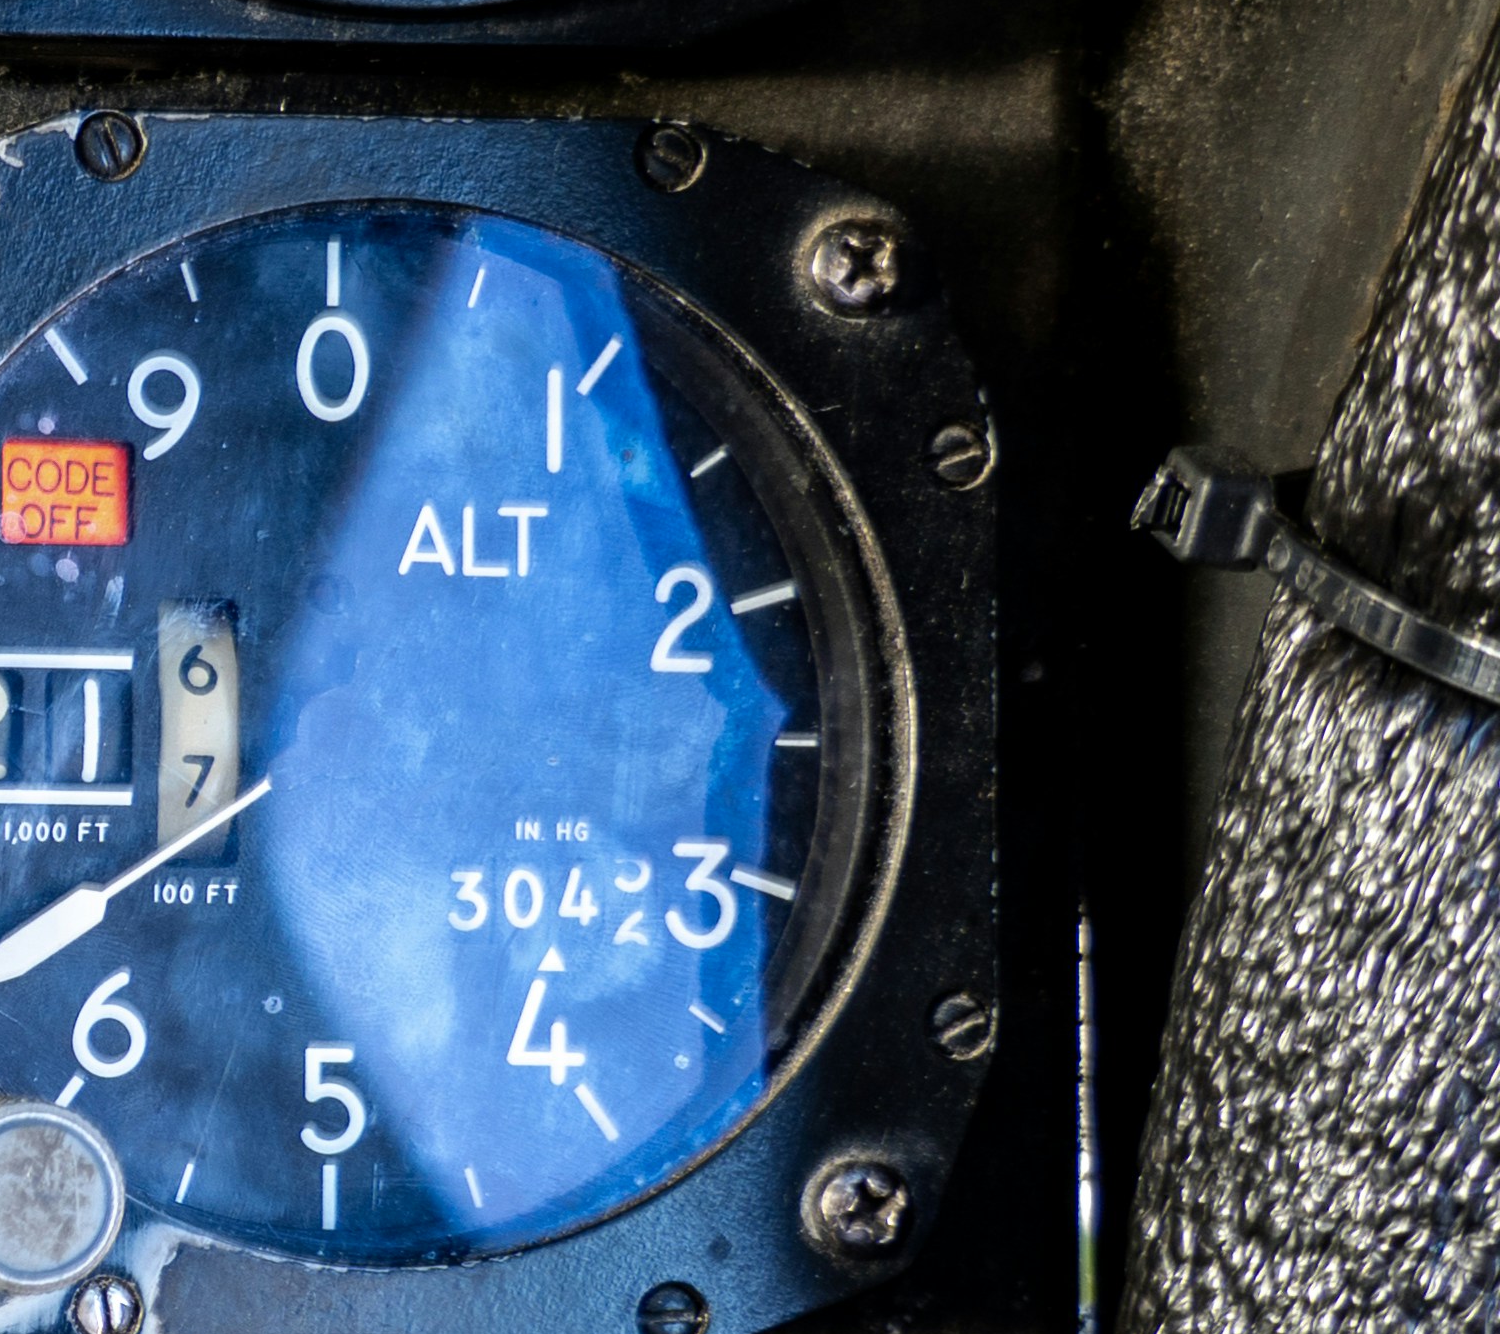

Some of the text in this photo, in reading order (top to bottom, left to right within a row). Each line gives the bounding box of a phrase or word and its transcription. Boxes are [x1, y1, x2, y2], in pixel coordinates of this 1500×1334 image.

[296, 315, 370, 422] 0
[127, 355, 200, 461] 9
[7, 457, 115, 497] CODE
[20, 503, 98, 540] OFF
[398, 503, 548, 578] ALT
[650, 566, 714, 673] 2
[178, 645, 218, 696] 6
[182, 754, 215, 808] 7
[3, 820, 110, 845] 1,000 FT
[556, 822, 590, 842] HG
[152, 883, 239, 905] 100 FT
[665, 842, 736, 949] 3
[72, 970, 147, 1079] 6
[506, 979, 586, 1086] 4
[300, 1045, 367, 1155] 5
